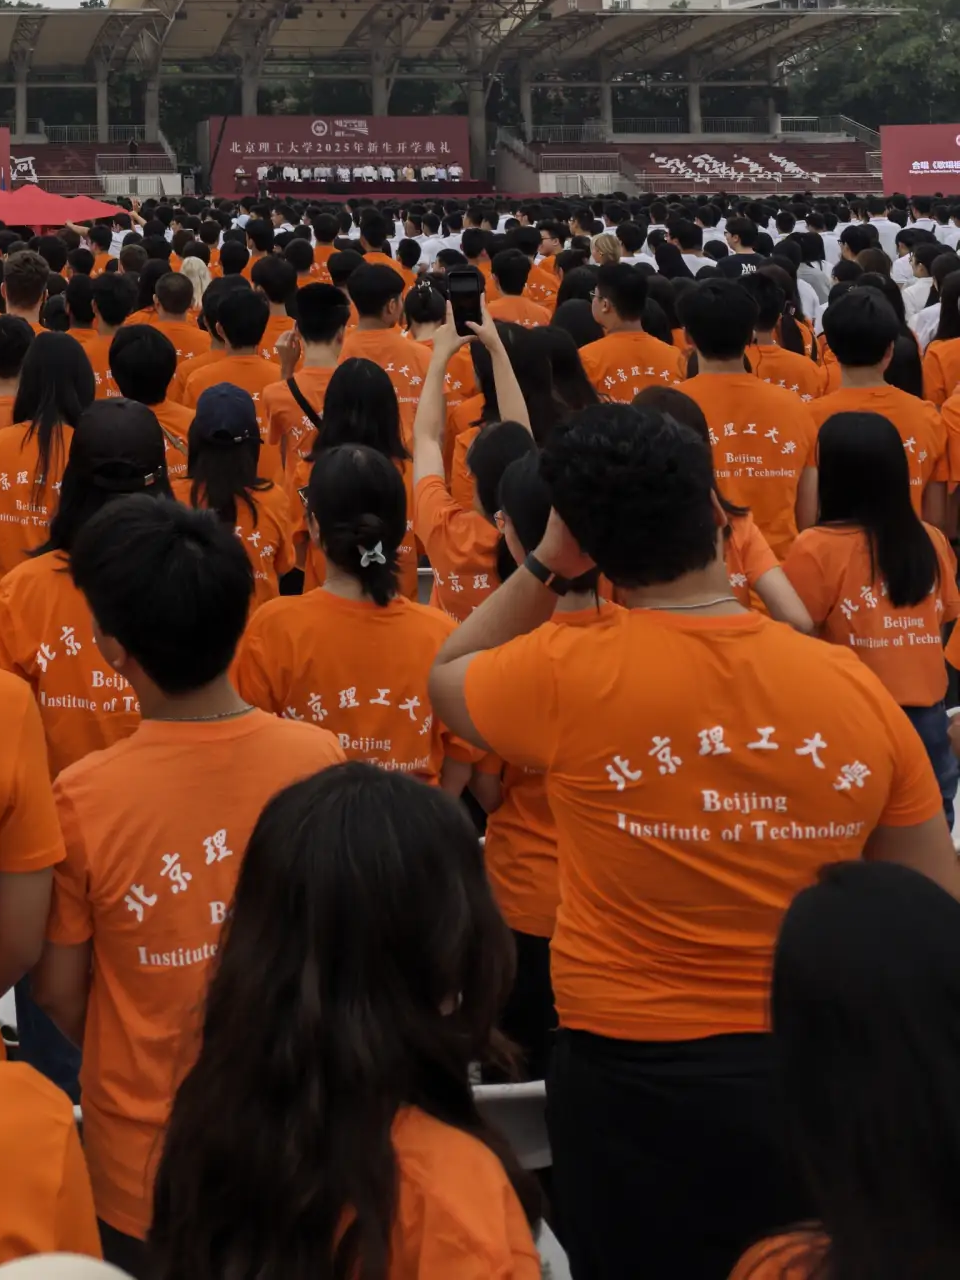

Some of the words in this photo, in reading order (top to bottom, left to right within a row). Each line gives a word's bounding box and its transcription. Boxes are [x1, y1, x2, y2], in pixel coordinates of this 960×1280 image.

[229, 141, 451, 154] 北京理工大学2025年新生开学典礼
[883, 616, 924, 630] Beijing
[41, 692, 97, 712] Institute
[103, 697, 117, 712] of
[338, 733, 392, 753] Beijing
[701, 789, 787, 813] Beijing
[617, 813, 711, 841] Institute
[721, 821, 742, 841] of
[137, 942, 218, 967] Institute
